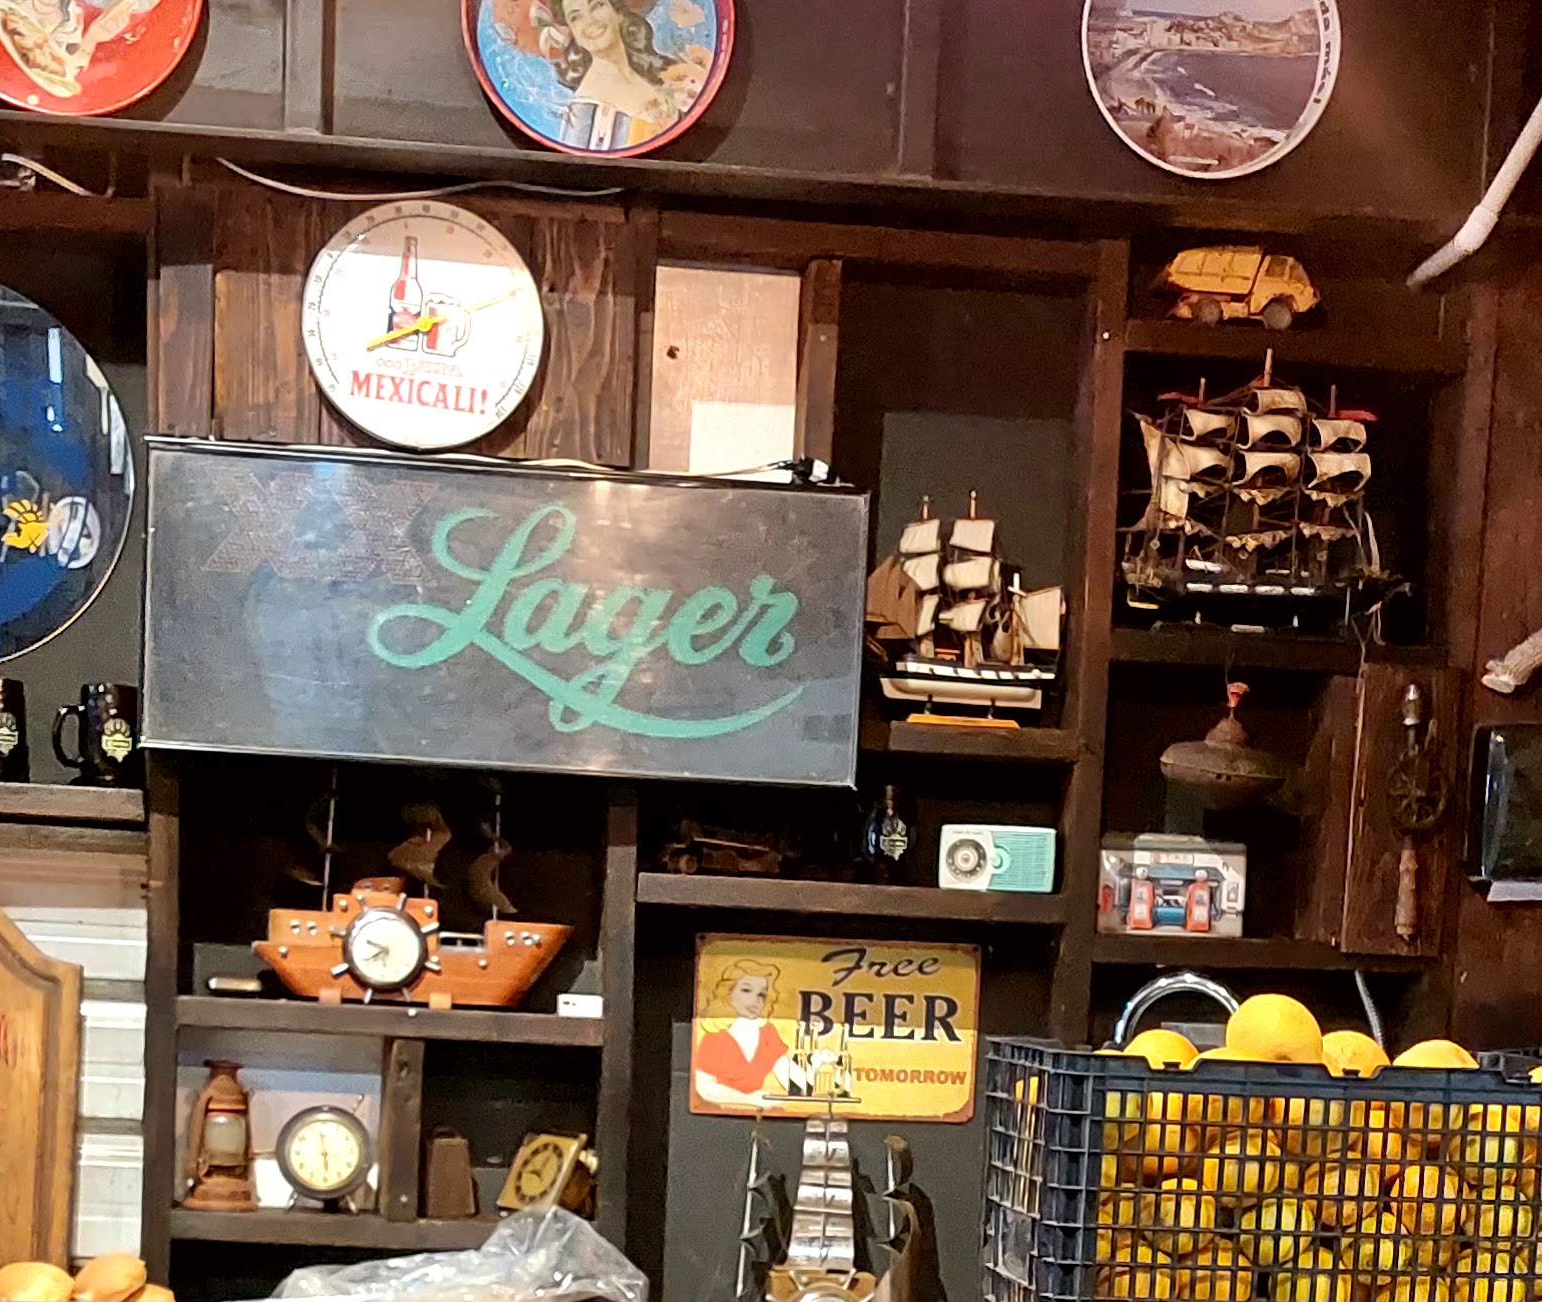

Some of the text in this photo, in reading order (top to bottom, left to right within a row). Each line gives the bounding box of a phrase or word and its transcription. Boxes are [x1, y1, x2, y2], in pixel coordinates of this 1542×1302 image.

[349, 370, 488, 415] MEXICALI!
[367, 502, 805, 740] Lager
[820, 946, 942, 988] Free
[798, 989, 963, 1043] BEER
[853, 1065, 968, 1086] TOMORROW
